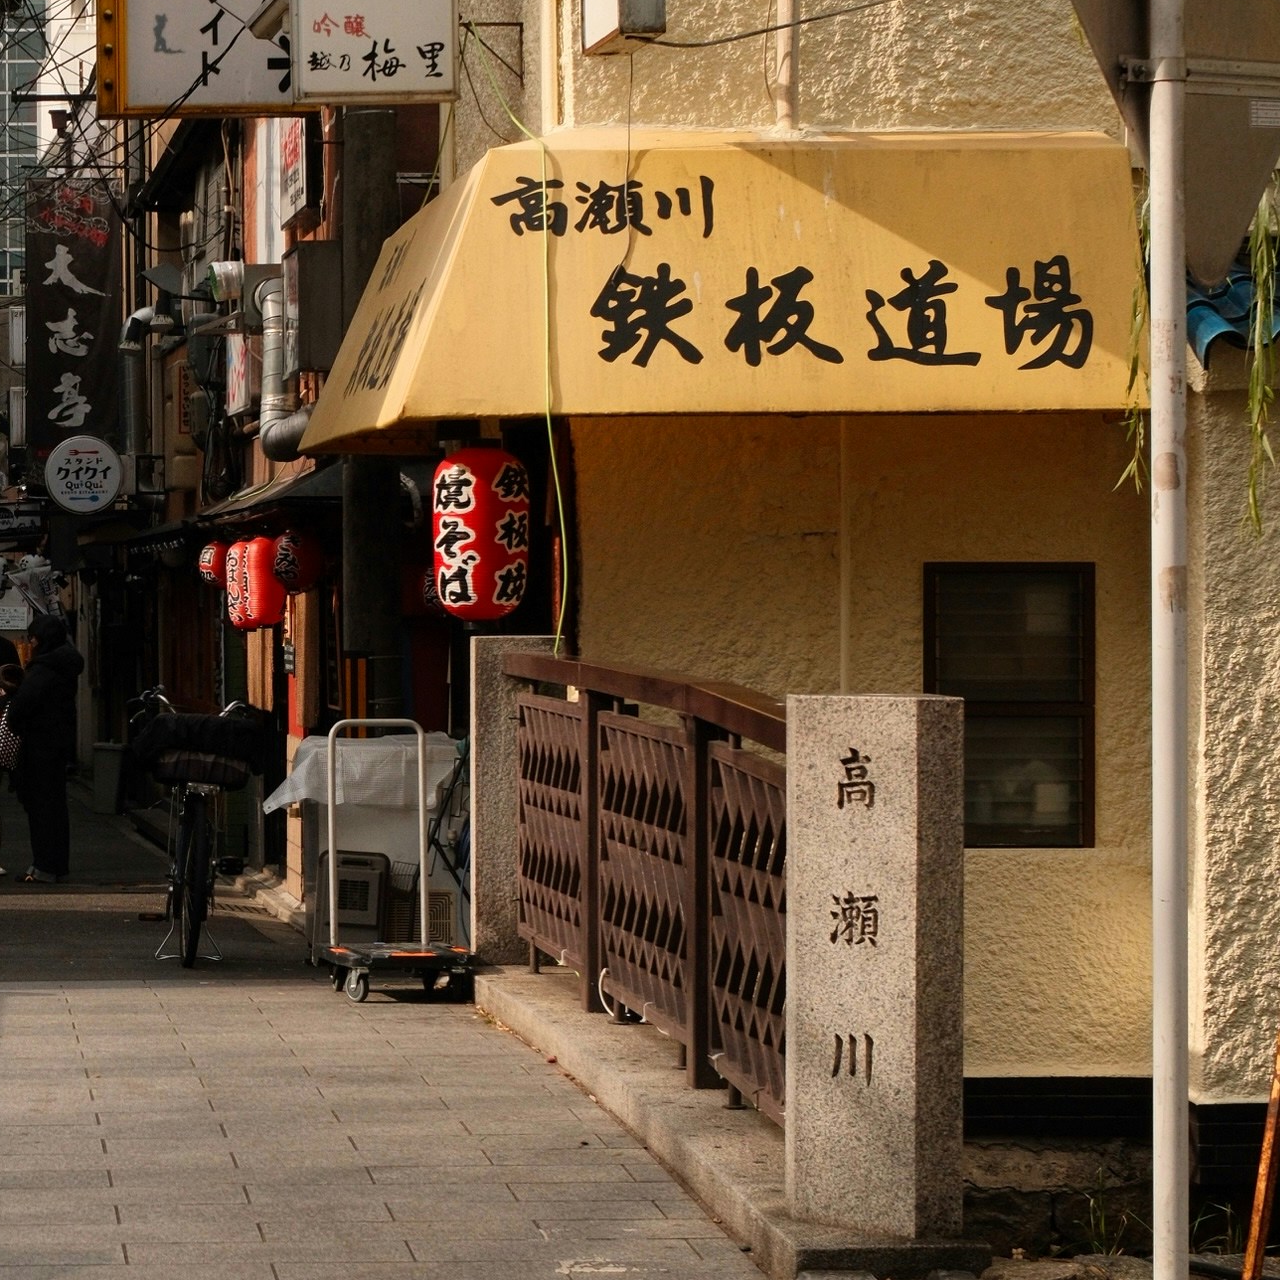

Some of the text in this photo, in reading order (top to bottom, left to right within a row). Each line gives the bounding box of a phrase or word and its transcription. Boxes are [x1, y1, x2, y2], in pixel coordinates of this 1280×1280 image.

[491, 175, 714, 238] 高瀬川
[590, 256, 1095, 370] 鉄板道場
[56, 466, 112, 480] クイクイ
[64, 457, 103, 465] スタンド
[830, 748, 878, 1088] 高瀬川
